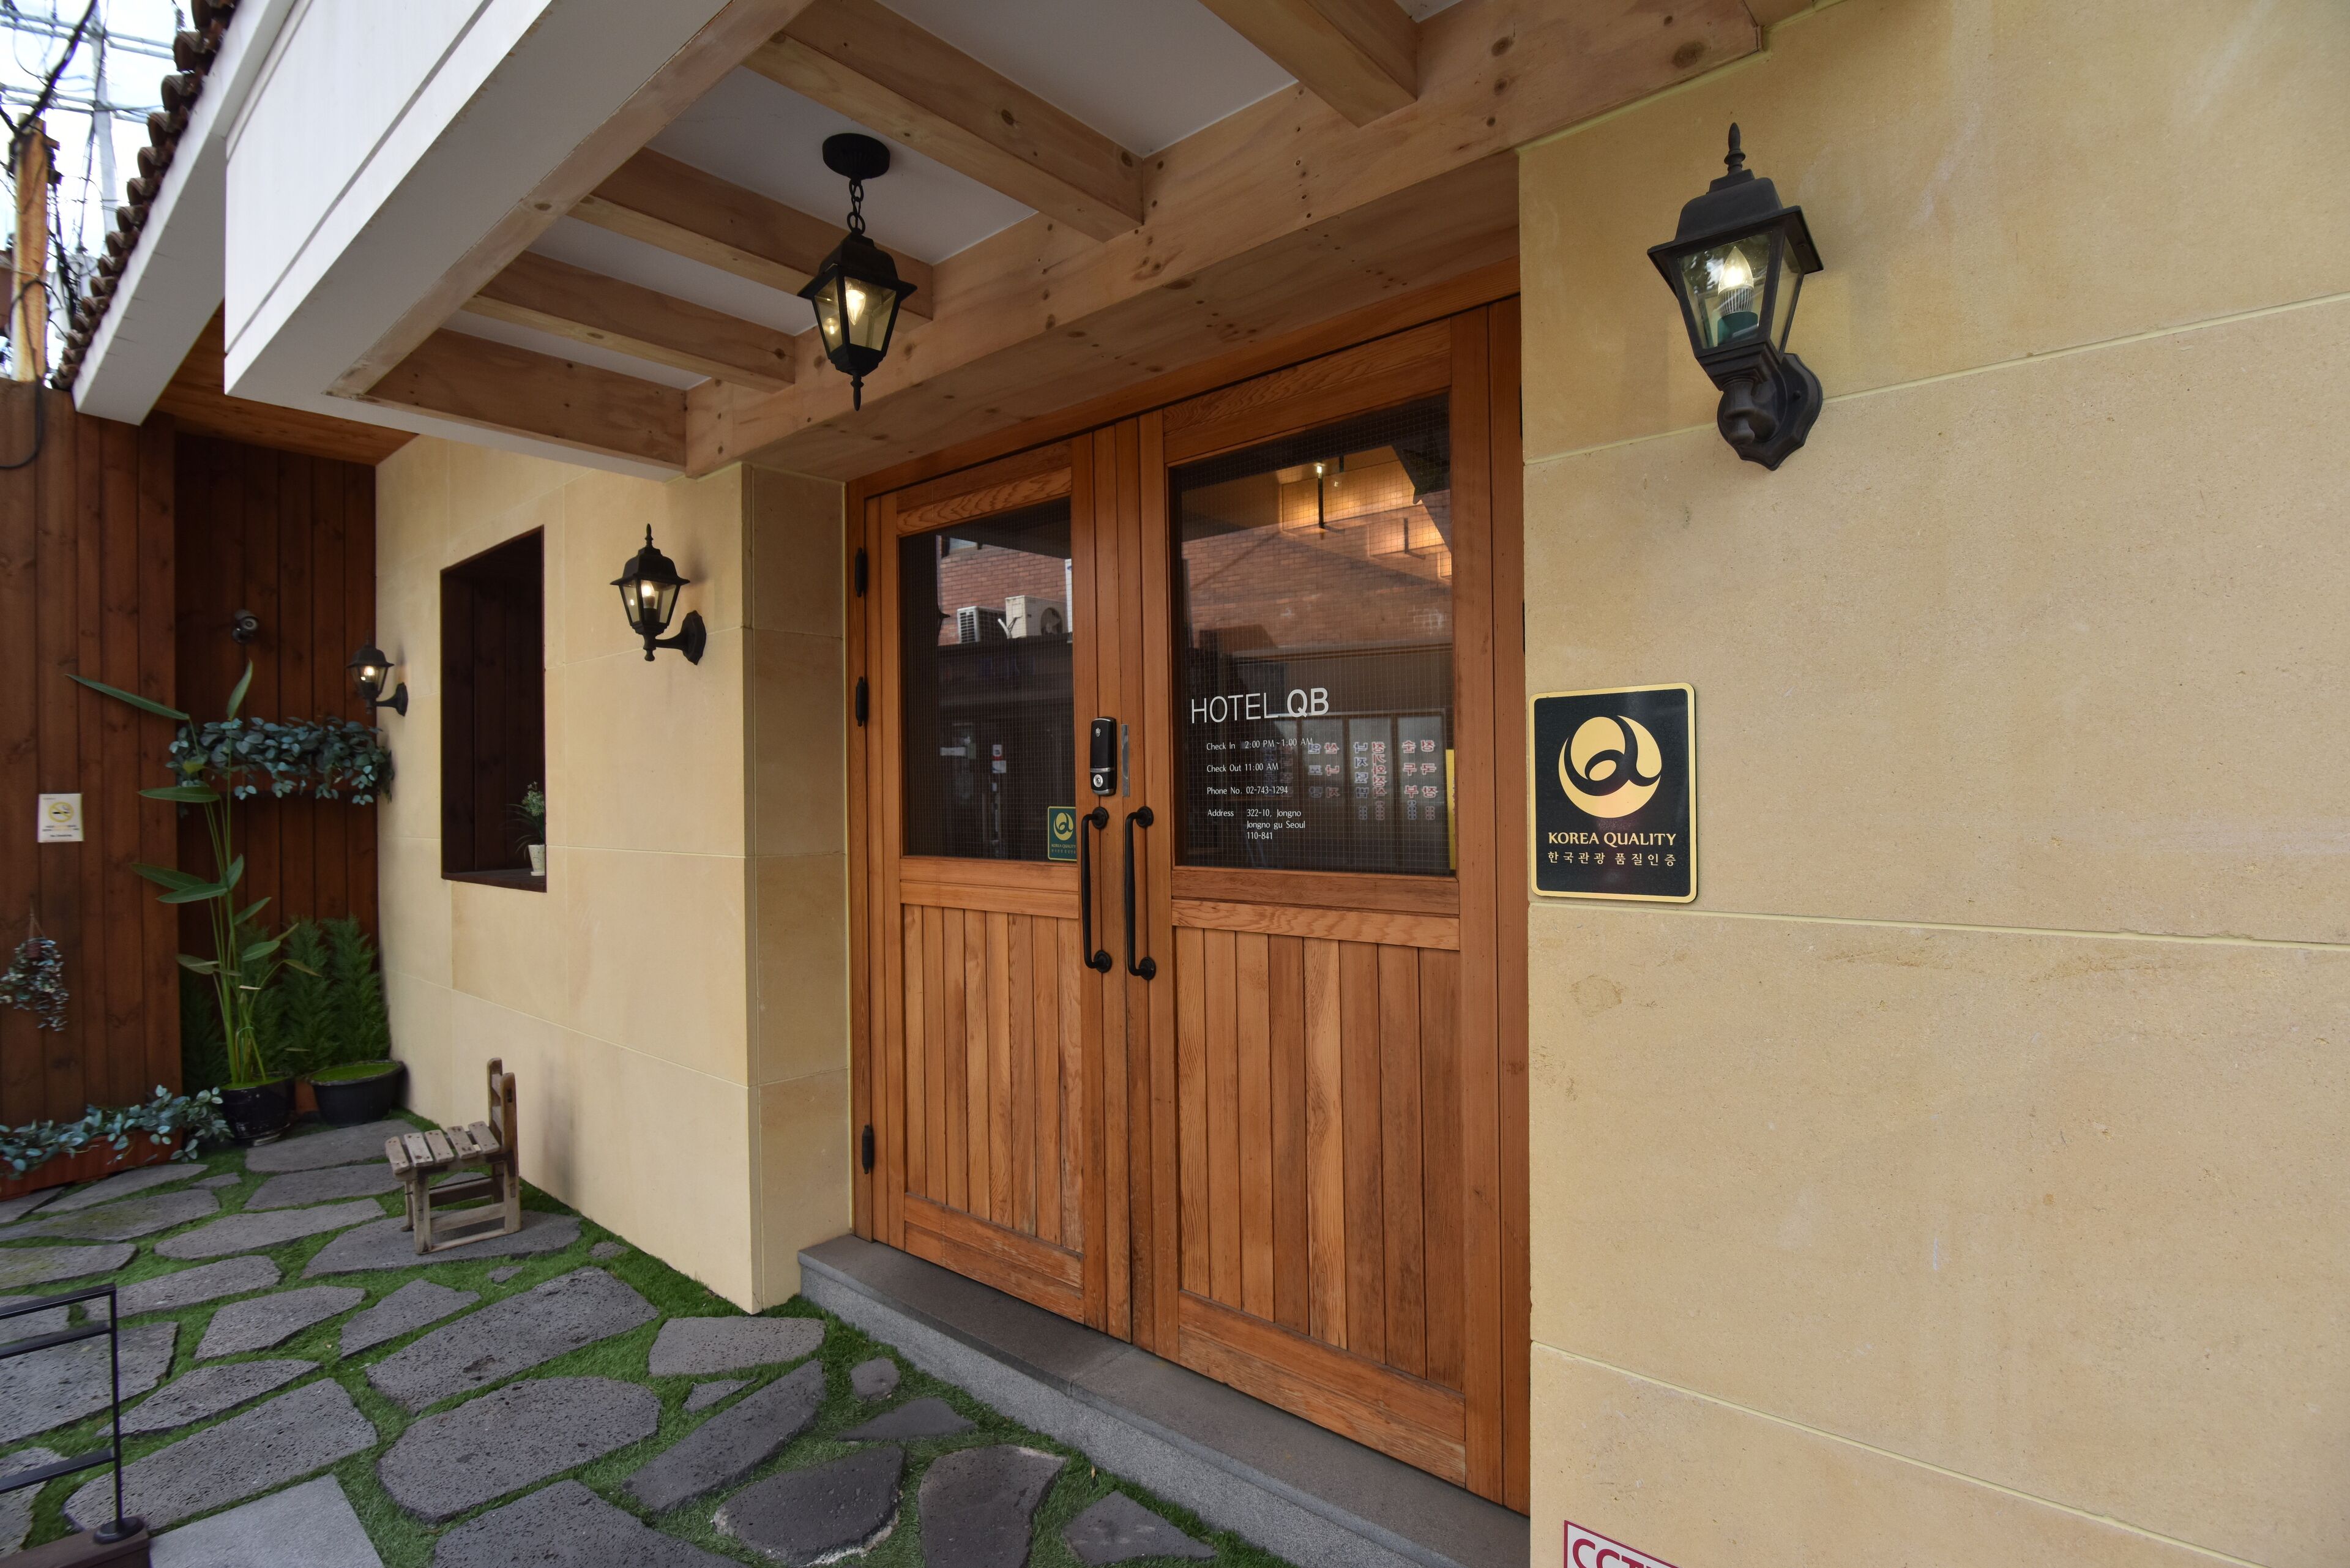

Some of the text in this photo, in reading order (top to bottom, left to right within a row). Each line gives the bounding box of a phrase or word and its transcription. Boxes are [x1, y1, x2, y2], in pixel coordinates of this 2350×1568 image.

[1192, 687, 1329, 723] HOTEL QB
[1206, 741, 1226, 750] Check
[1277, 808, 1301, 818] Jongno
[1247, 820, 1270, 829] Jongno
[1548, 832, 1677, 848] KOREA QUALITY
[1548, 851, 1676, 867] 한국관광 품질인증
